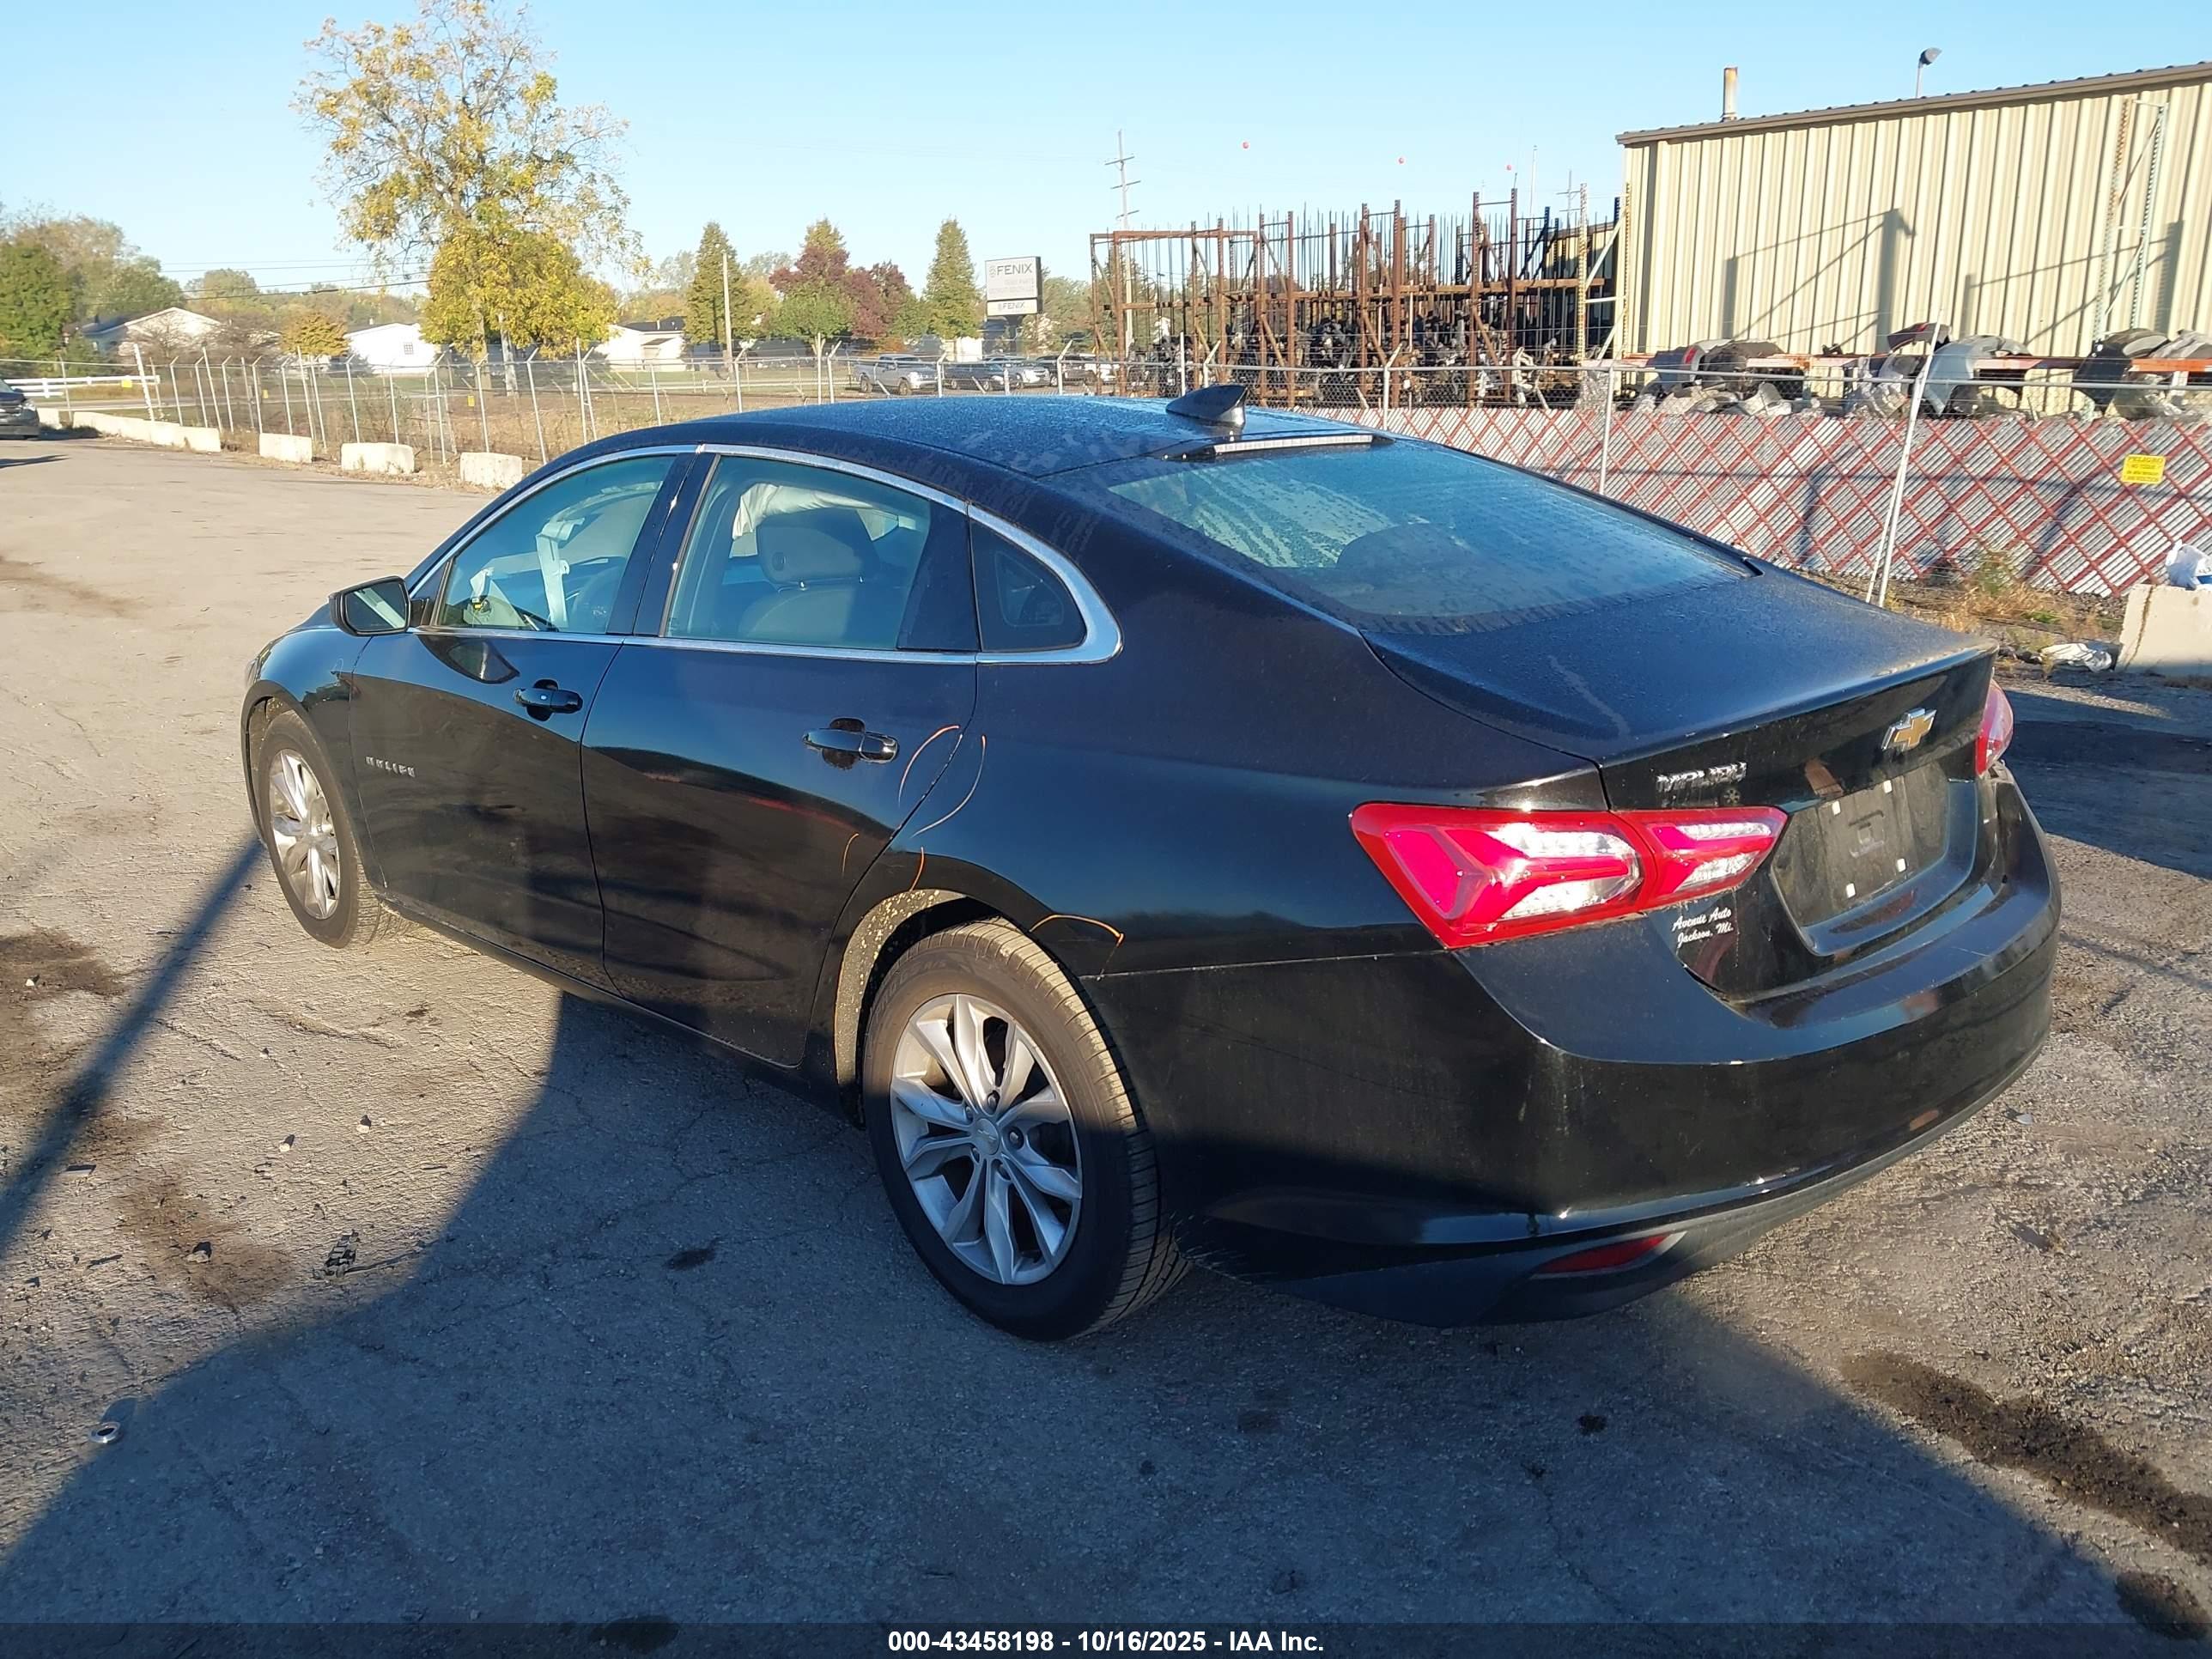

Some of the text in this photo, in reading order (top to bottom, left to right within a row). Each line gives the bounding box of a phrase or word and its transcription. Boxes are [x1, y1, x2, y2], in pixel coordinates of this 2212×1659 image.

[997, 264, 1032, 275] FENIX
[1671, 906, 1732, 932] Avenue Auto
[1715, 921, 1735, 934] Mi.
